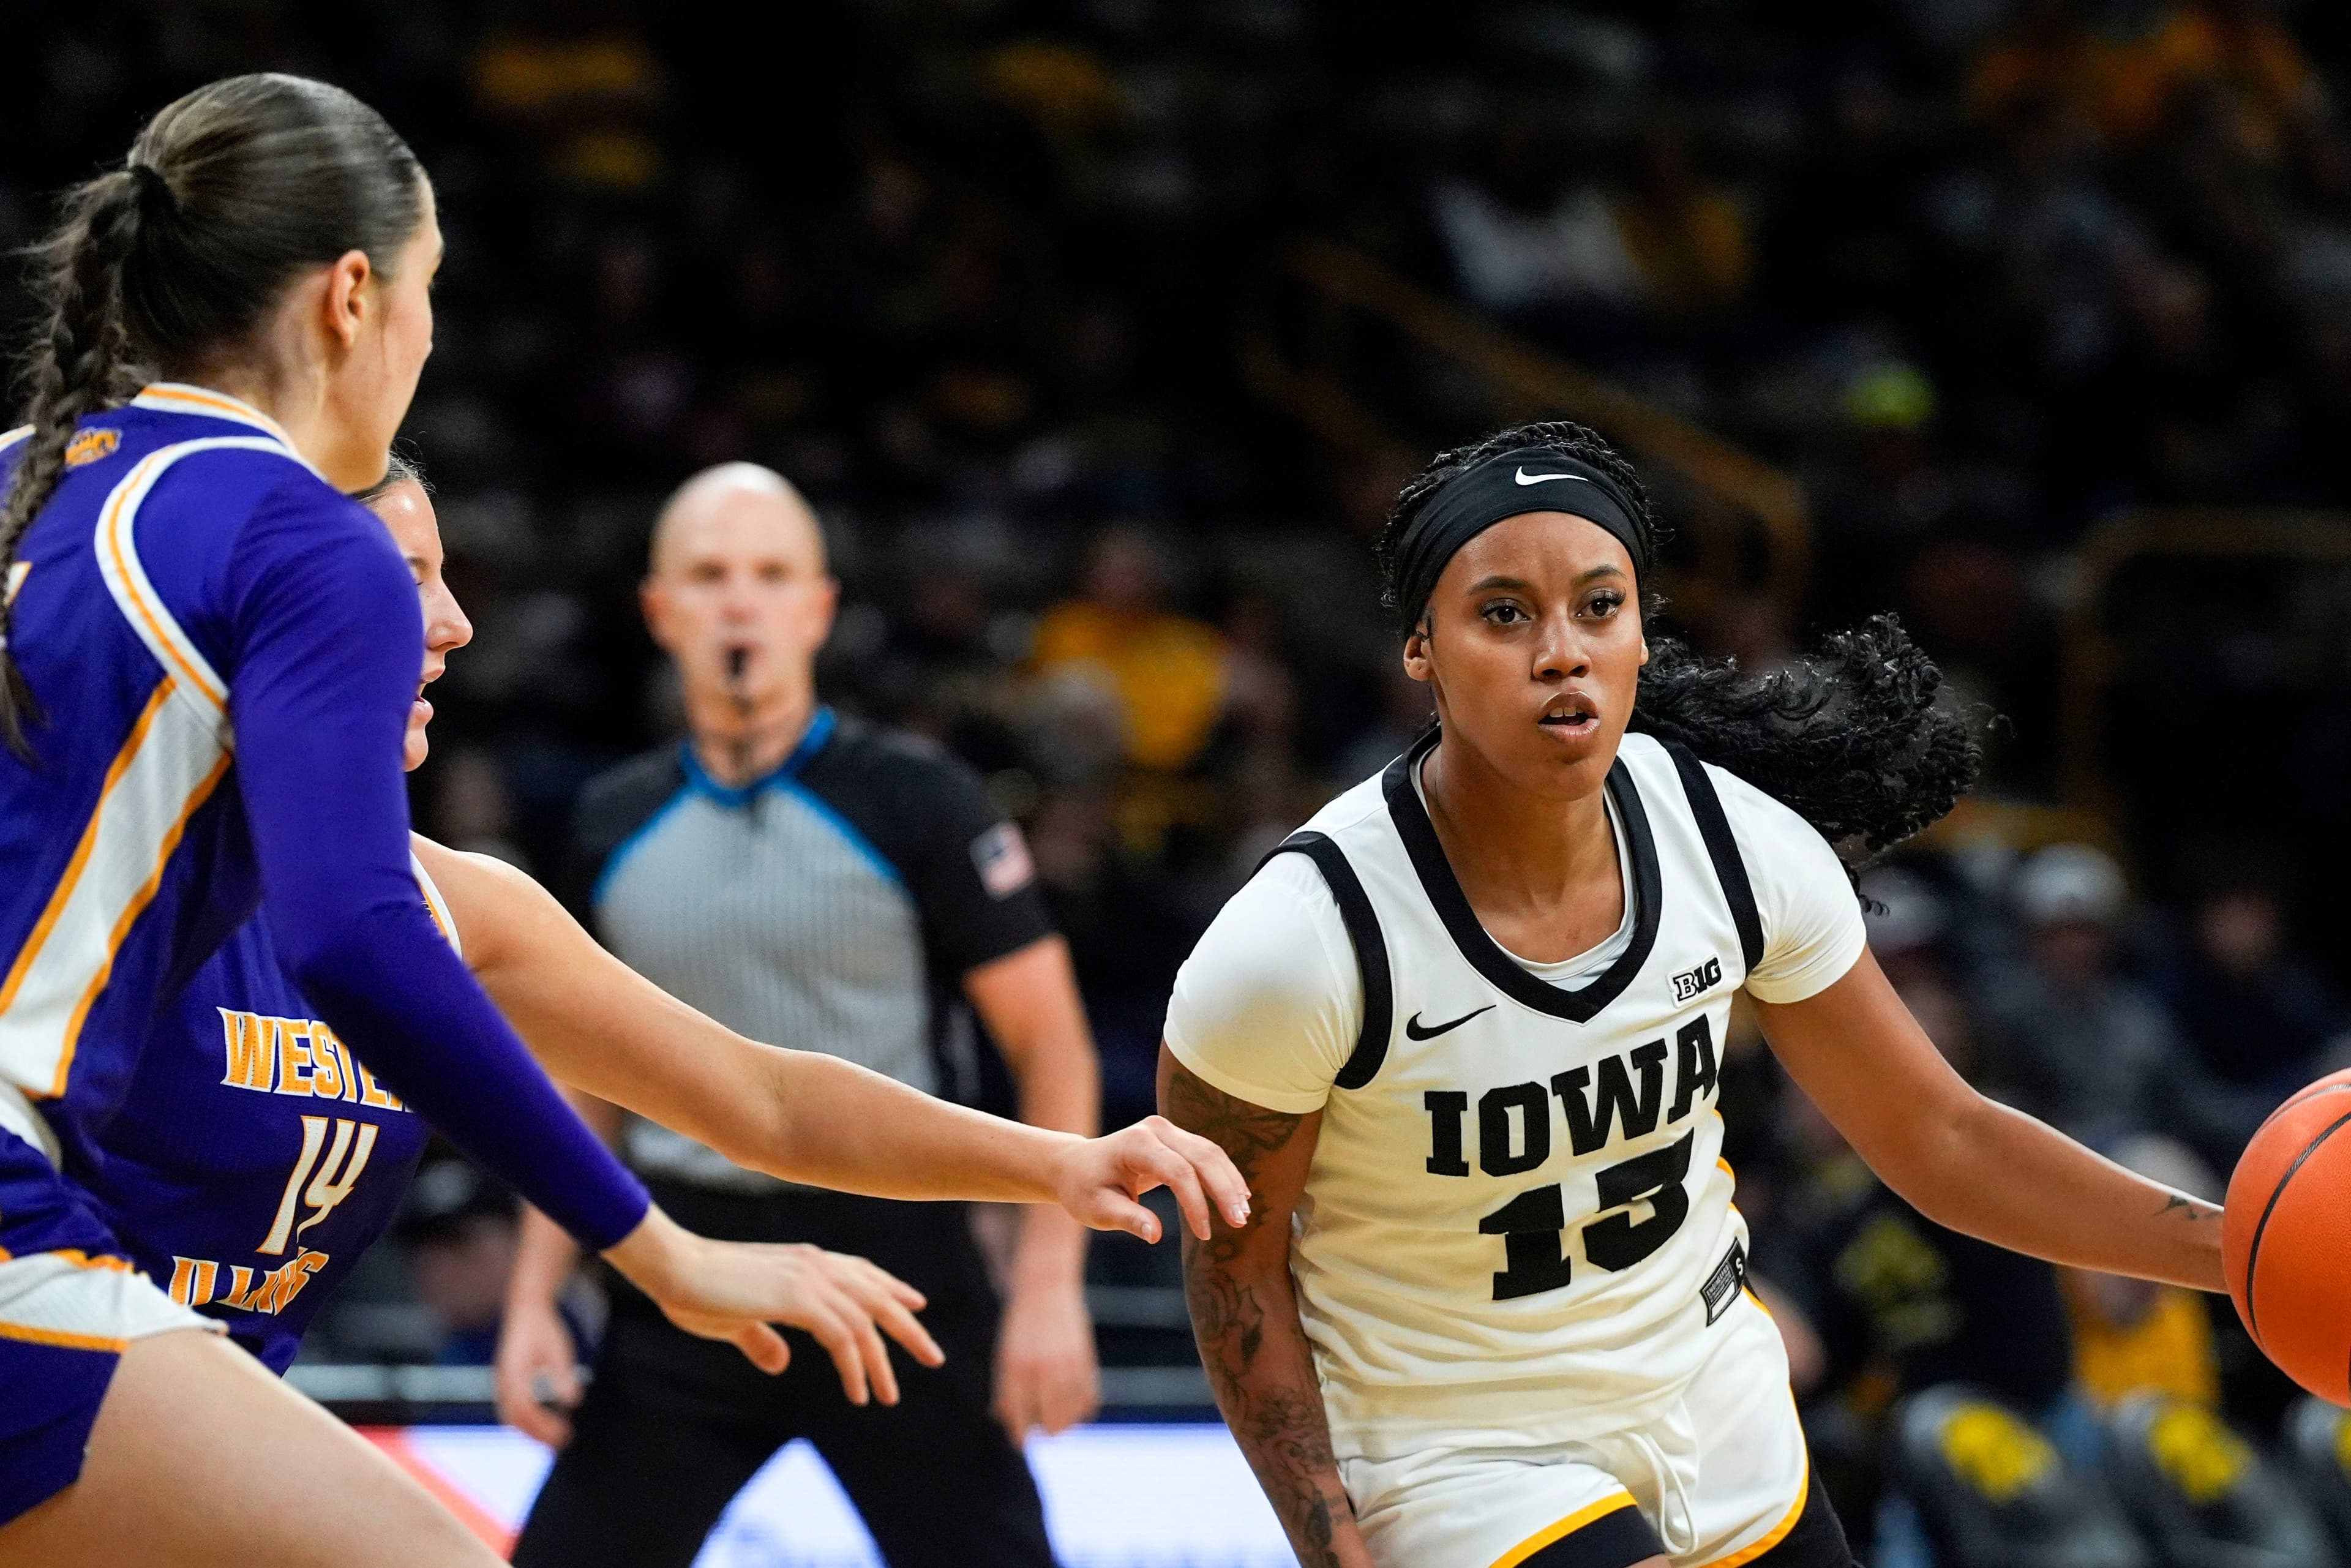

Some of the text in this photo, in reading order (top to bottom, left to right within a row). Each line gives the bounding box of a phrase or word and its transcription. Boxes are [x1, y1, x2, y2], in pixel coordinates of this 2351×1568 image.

[1424, 1013, 1717, 1177] IOWA
[254, 1115, 380, 1255] 14
[1479, 1127, 1695, 1300] 13
